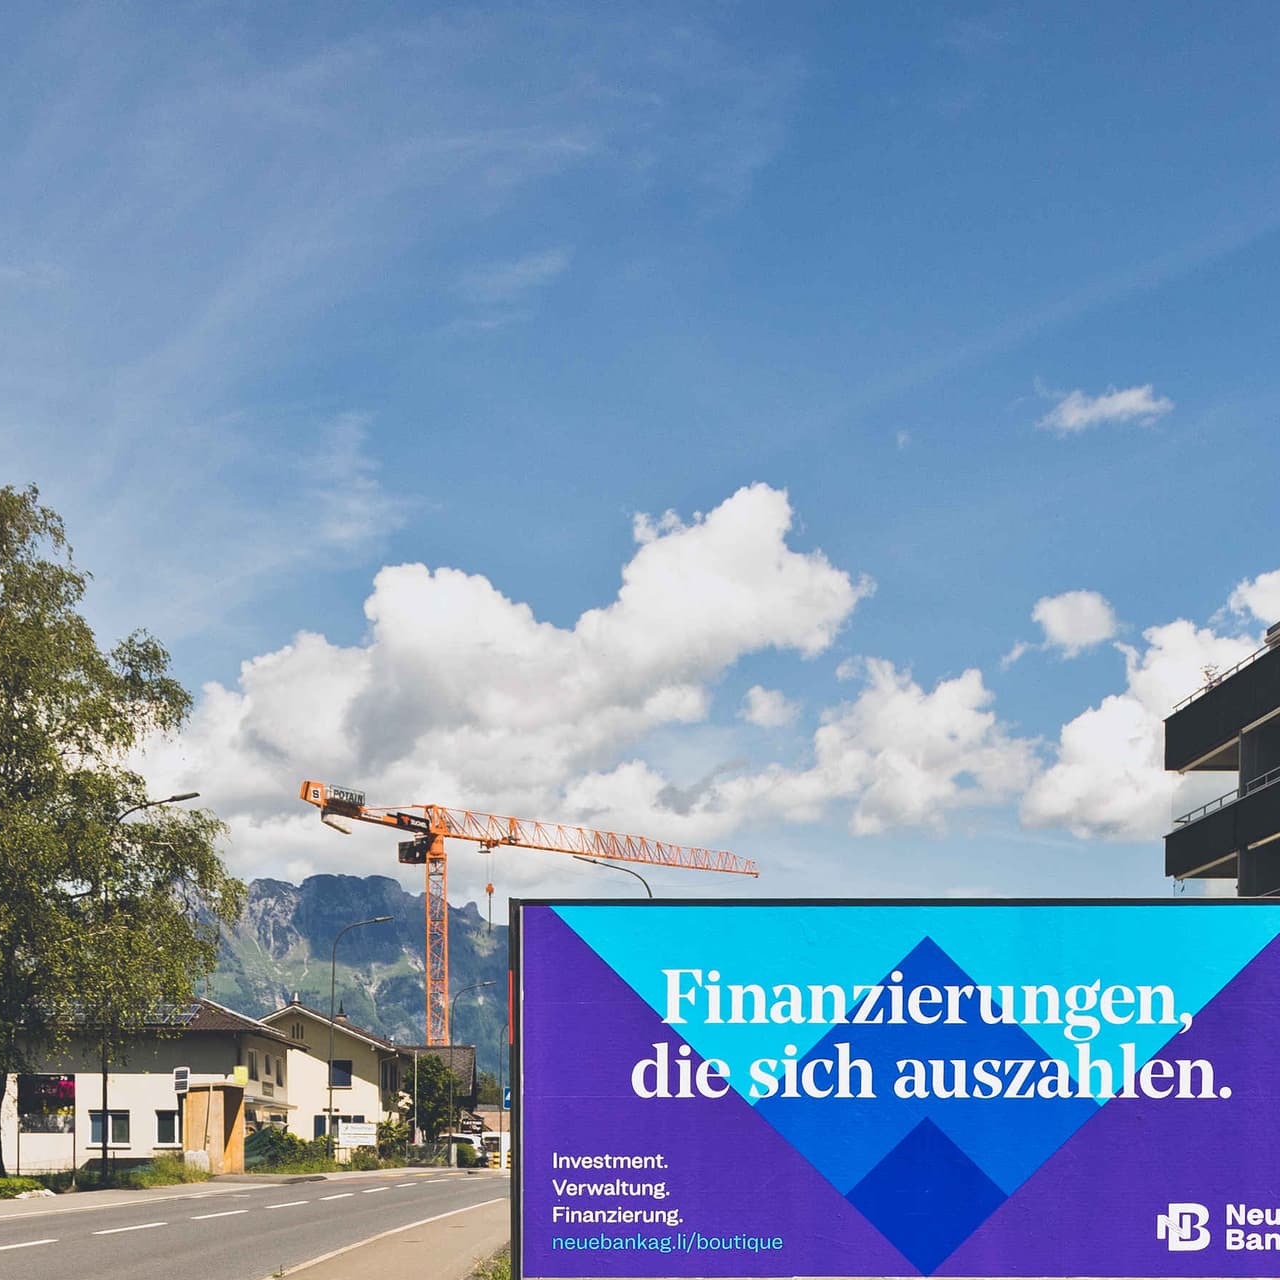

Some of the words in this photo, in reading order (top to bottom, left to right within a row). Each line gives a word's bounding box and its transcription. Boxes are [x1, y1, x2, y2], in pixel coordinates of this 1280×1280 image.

[333, 788, 364, 805] POTAIN
[660, 969, 1193, 1041] Finanzierungen,
[632, 1042, 731, 1099] die
[749, 1042, 877, 1099] sich
[893, 1042, 1232, 1099] auszahlen.
[552, 1152, 669, 1169] Investment.
[552, 1179, 671, 1200] Verwaltung.
[552, 1206, 684, 1227] Finanzierung.
[552, 1231, 784, 1254] neuebankag.li/boutique
